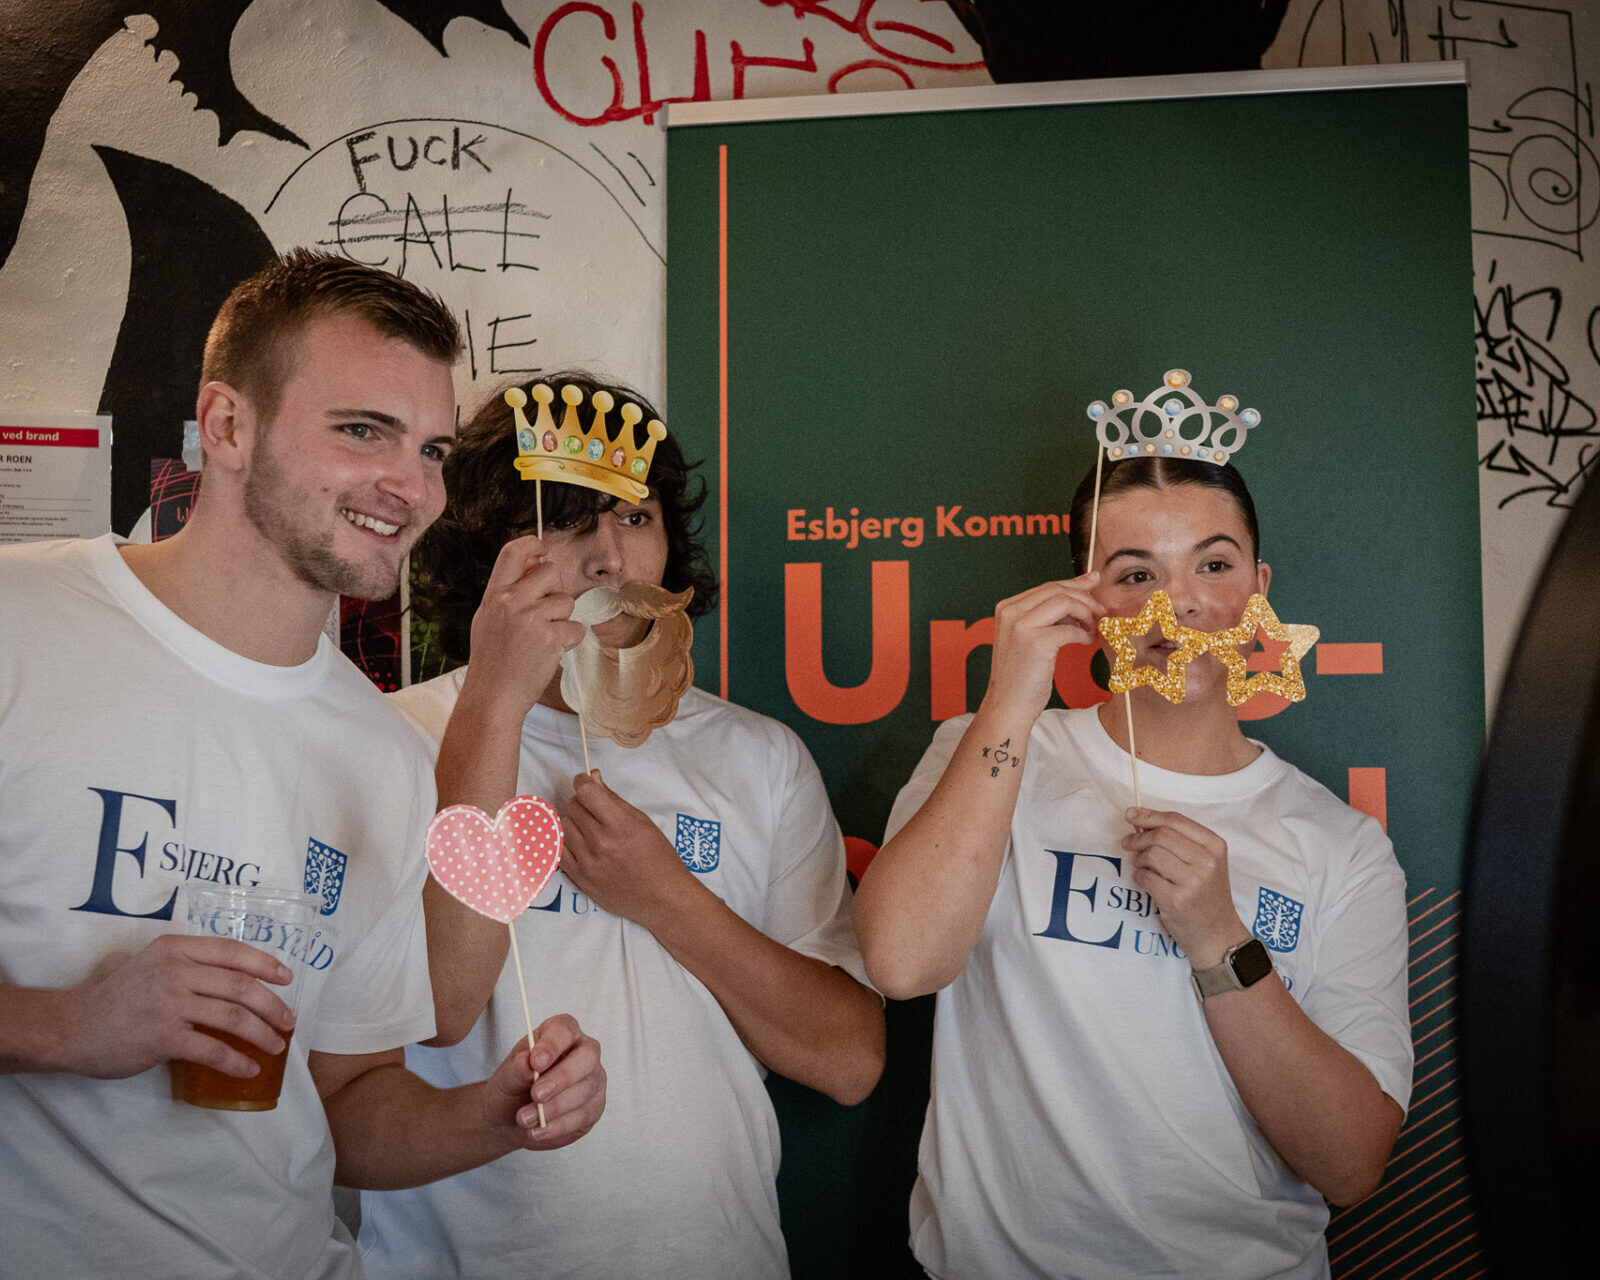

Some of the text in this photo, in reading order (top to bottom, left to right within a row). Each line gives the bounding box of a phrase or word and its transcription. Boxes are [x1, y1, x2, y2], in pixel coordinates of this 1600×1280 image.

[346, 126, 491, 193] FUCK
[2, 430, 60, 441] ved brand
[6, 455, 32, 463] ROEN
[787, 507, 924, 548] Esbjerg
